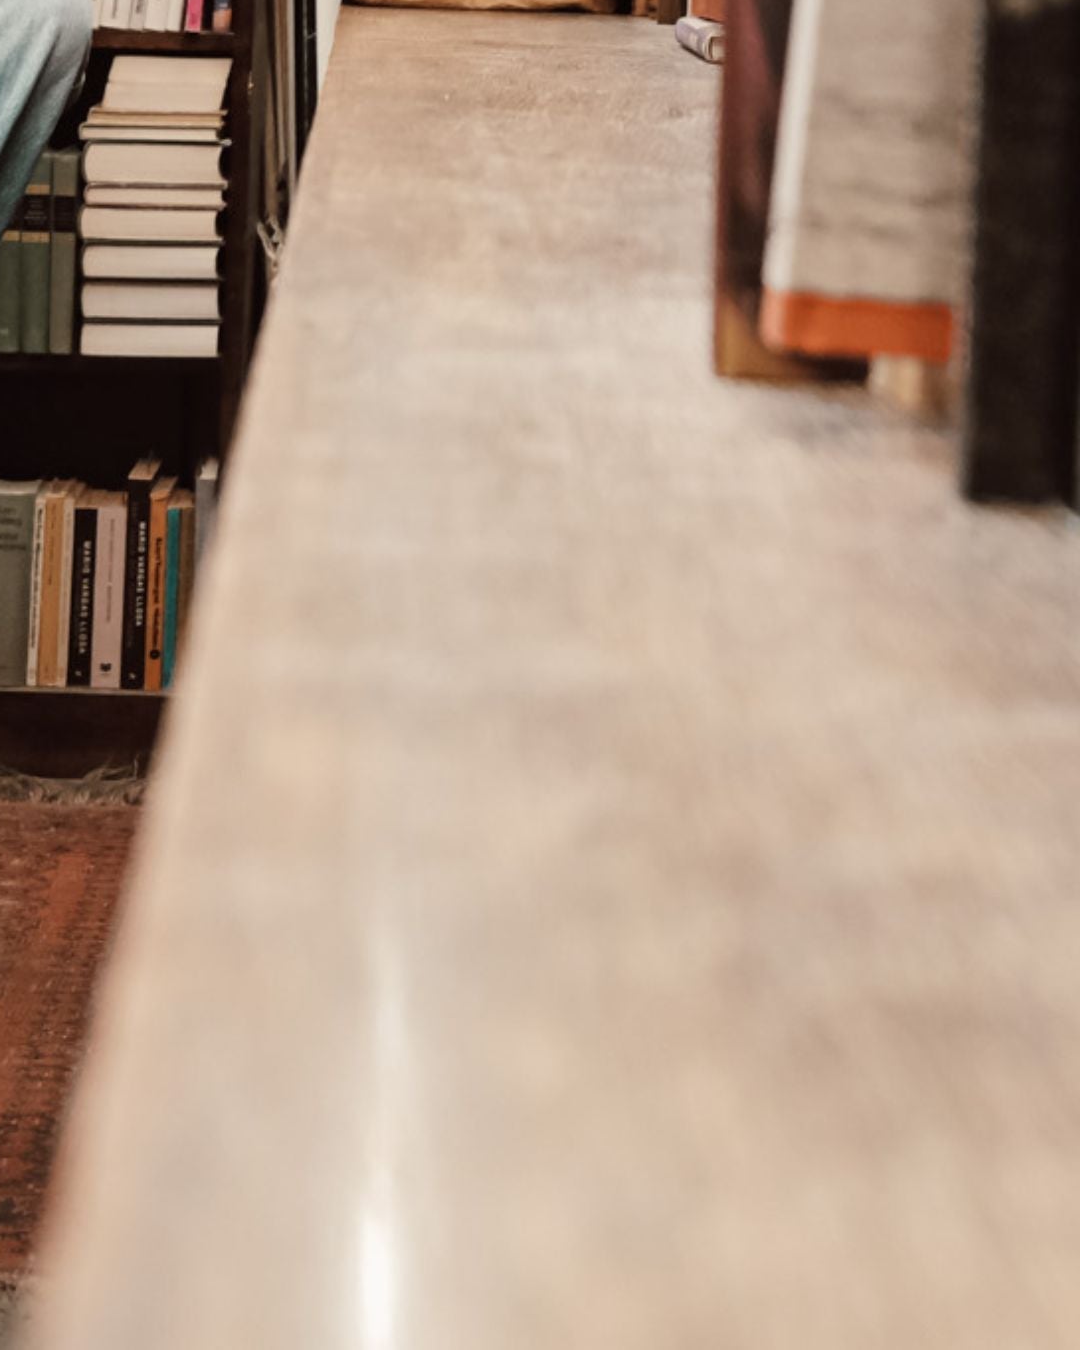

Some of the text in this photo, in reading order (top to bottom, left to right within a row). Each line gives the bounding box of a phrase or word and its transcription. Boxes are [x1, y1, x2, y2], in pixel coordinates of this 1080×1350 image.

[78, 540, 92, 655] MARIO VARGAS LLOSA
[134, 521, 147, 627] MARIO VARGAS LLOSA
